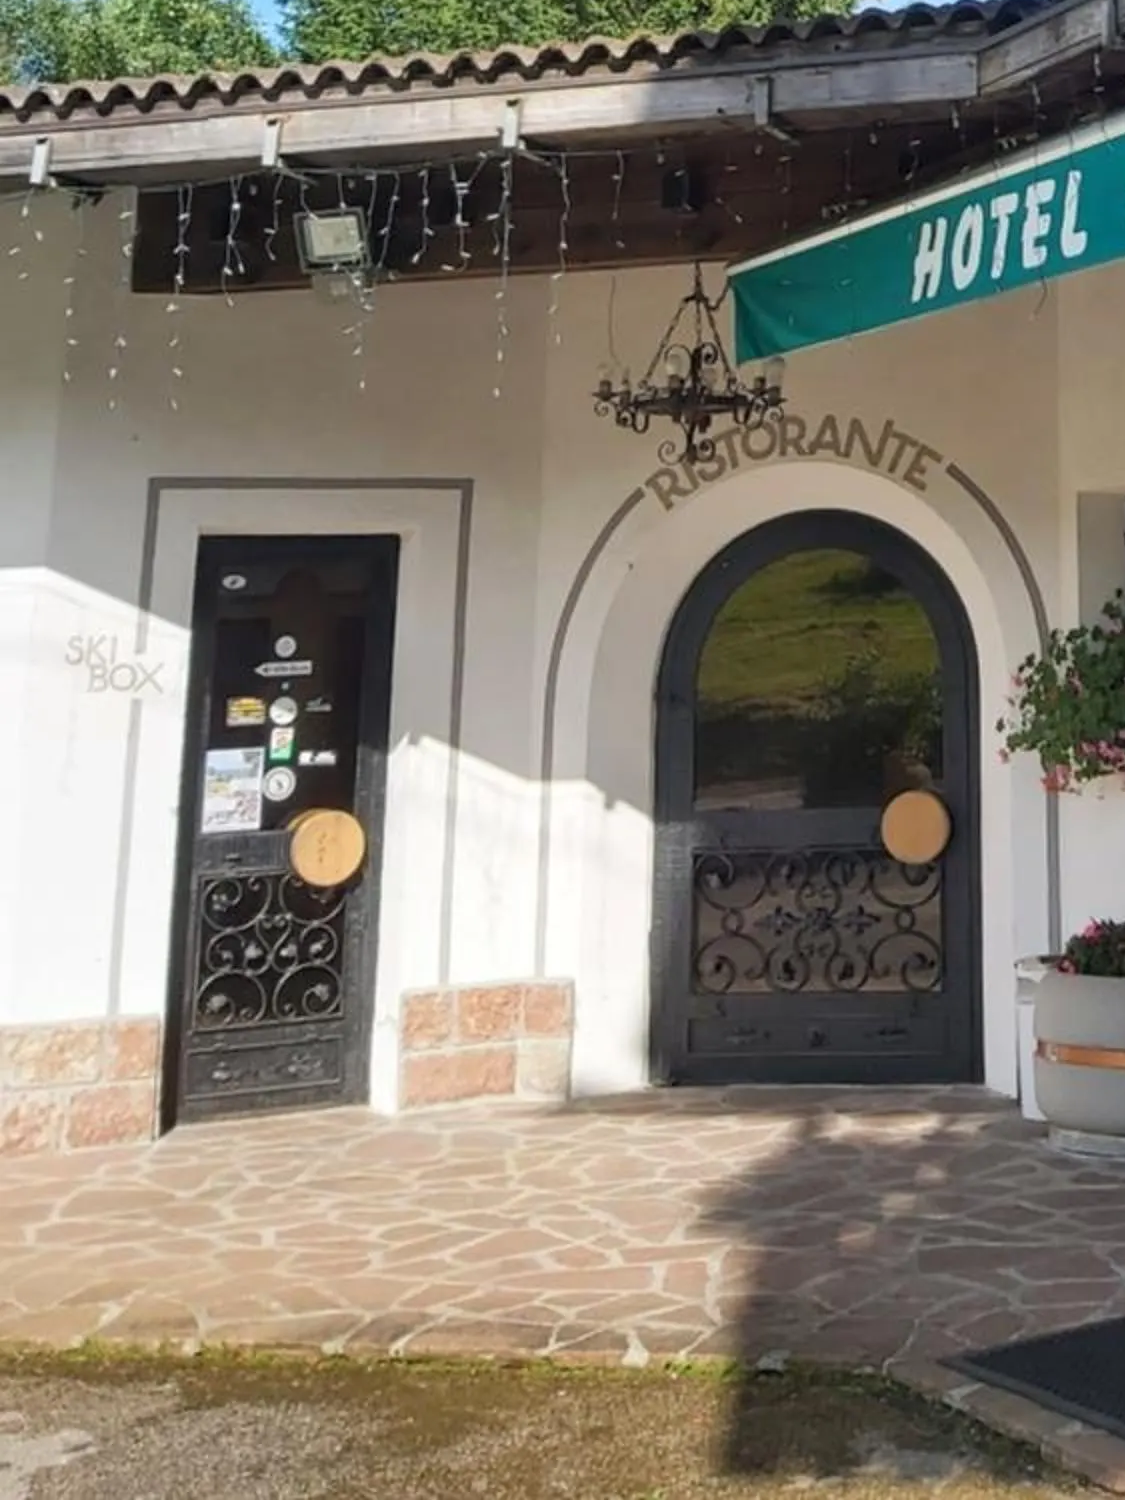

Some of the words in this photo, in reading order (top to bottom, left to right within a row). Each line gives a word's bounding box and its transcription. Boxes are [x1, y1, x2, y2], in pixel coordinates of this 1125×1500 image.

[910, 170, 1089, 303] HOTEL
[645, 414, 943, 511] RISTORANTE
[65, 634, 118, 666] SKI
[87, 661, 164, 694] BOX
